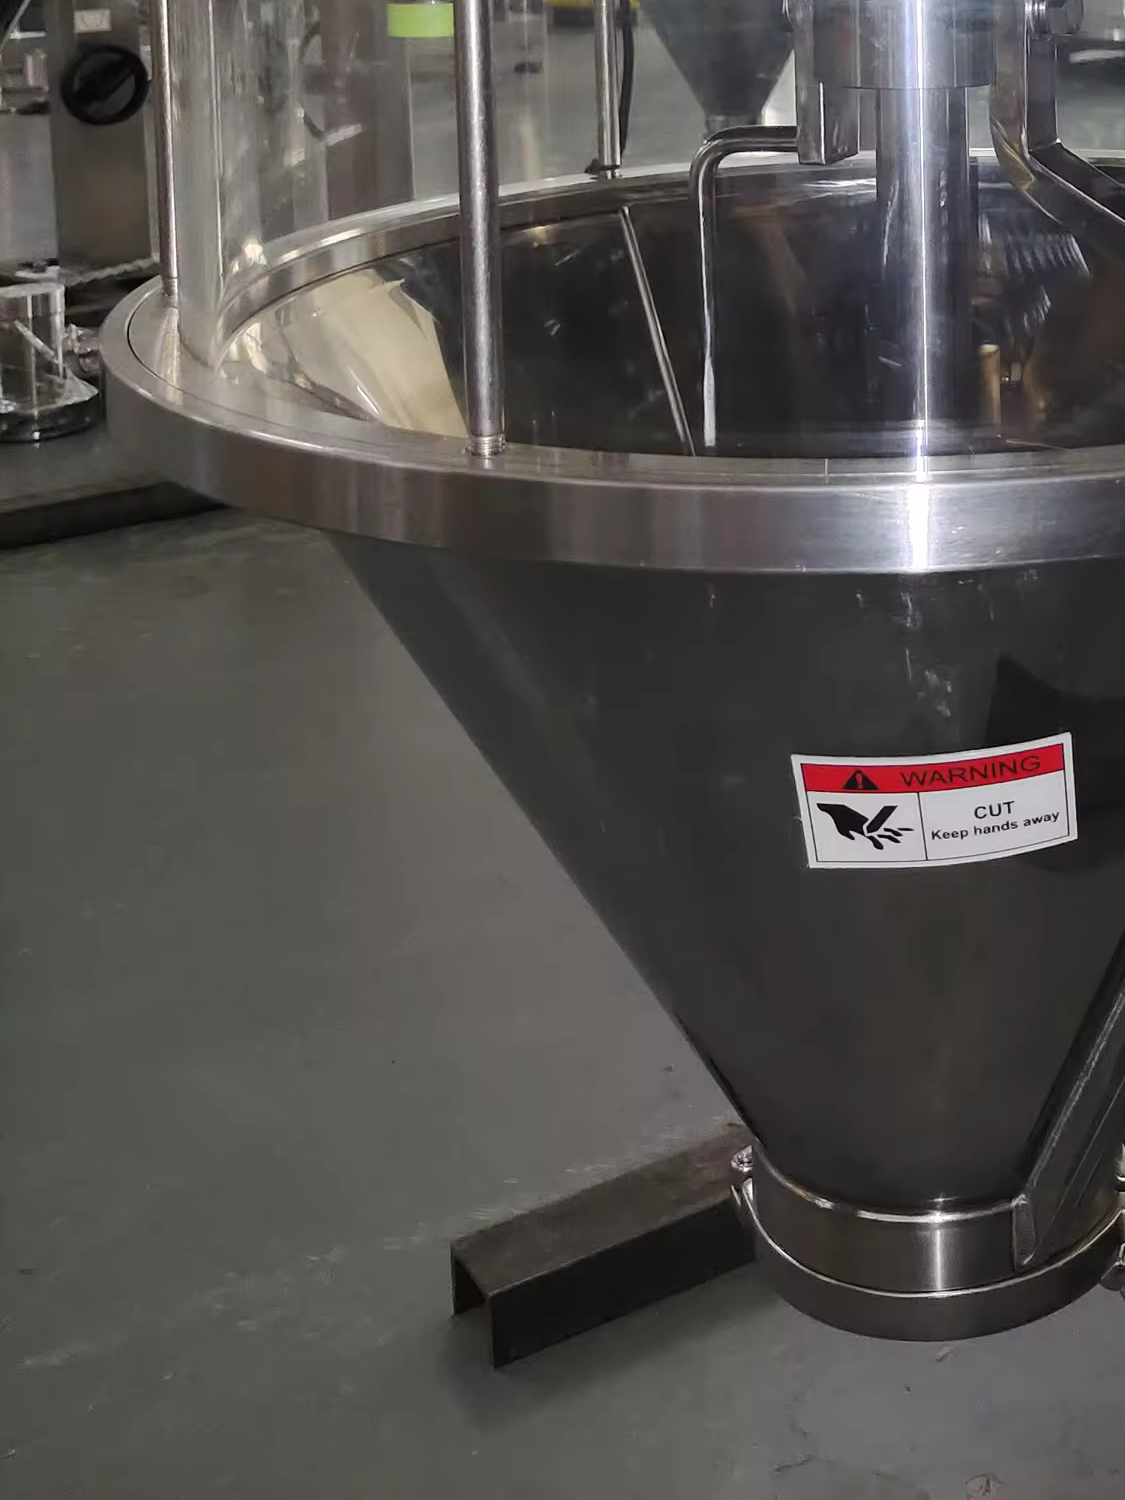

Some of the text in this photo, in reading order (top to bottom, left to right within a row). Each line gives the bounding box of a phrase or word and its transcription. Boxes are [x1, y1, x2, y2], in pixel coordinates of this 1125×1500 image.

[899, 754, 1042, 788] WARNING
[973, 801, 1015, 820] CUT
[930, 811, 1060, 841] Keep hands away
